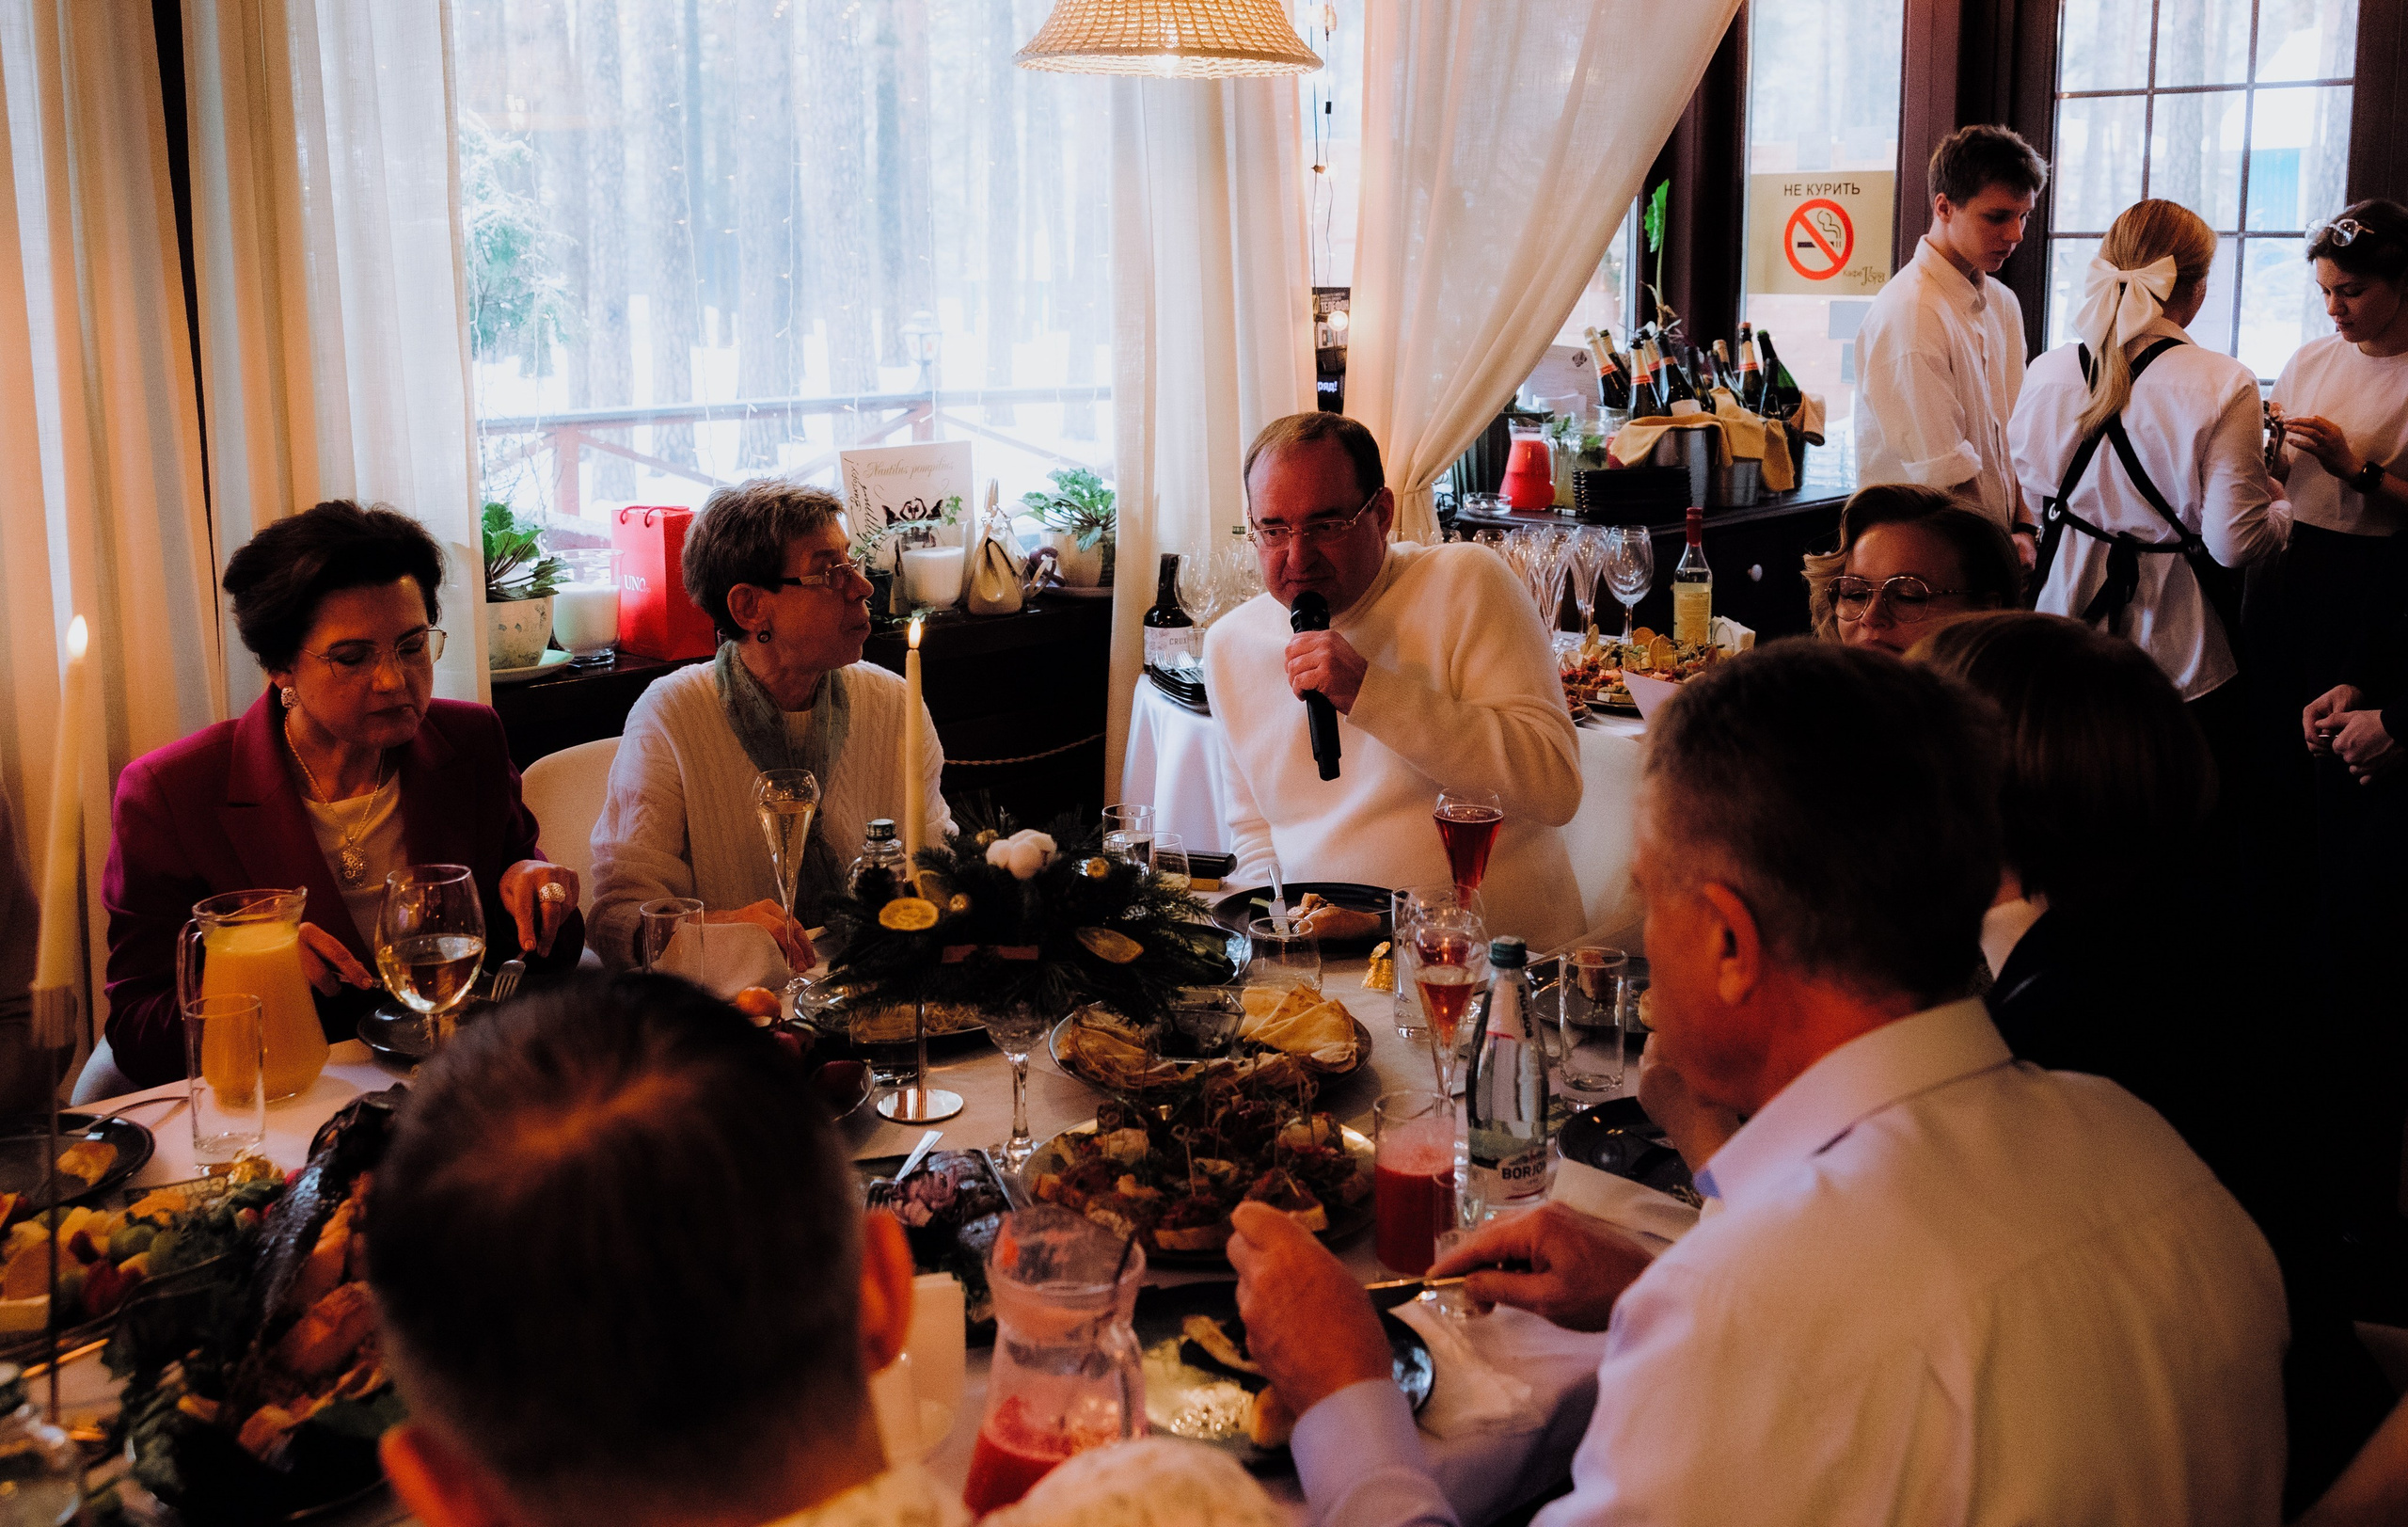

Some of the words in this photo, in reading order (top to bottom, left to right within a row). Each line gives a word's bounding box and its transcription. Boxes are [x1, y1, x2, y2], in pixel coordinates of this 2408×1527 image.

[1783, 183, 1802, 196] НЕ
[1806, 183, 1861, 196] КУРИТЬ
[863, 458, 909, 478] Nautilus
